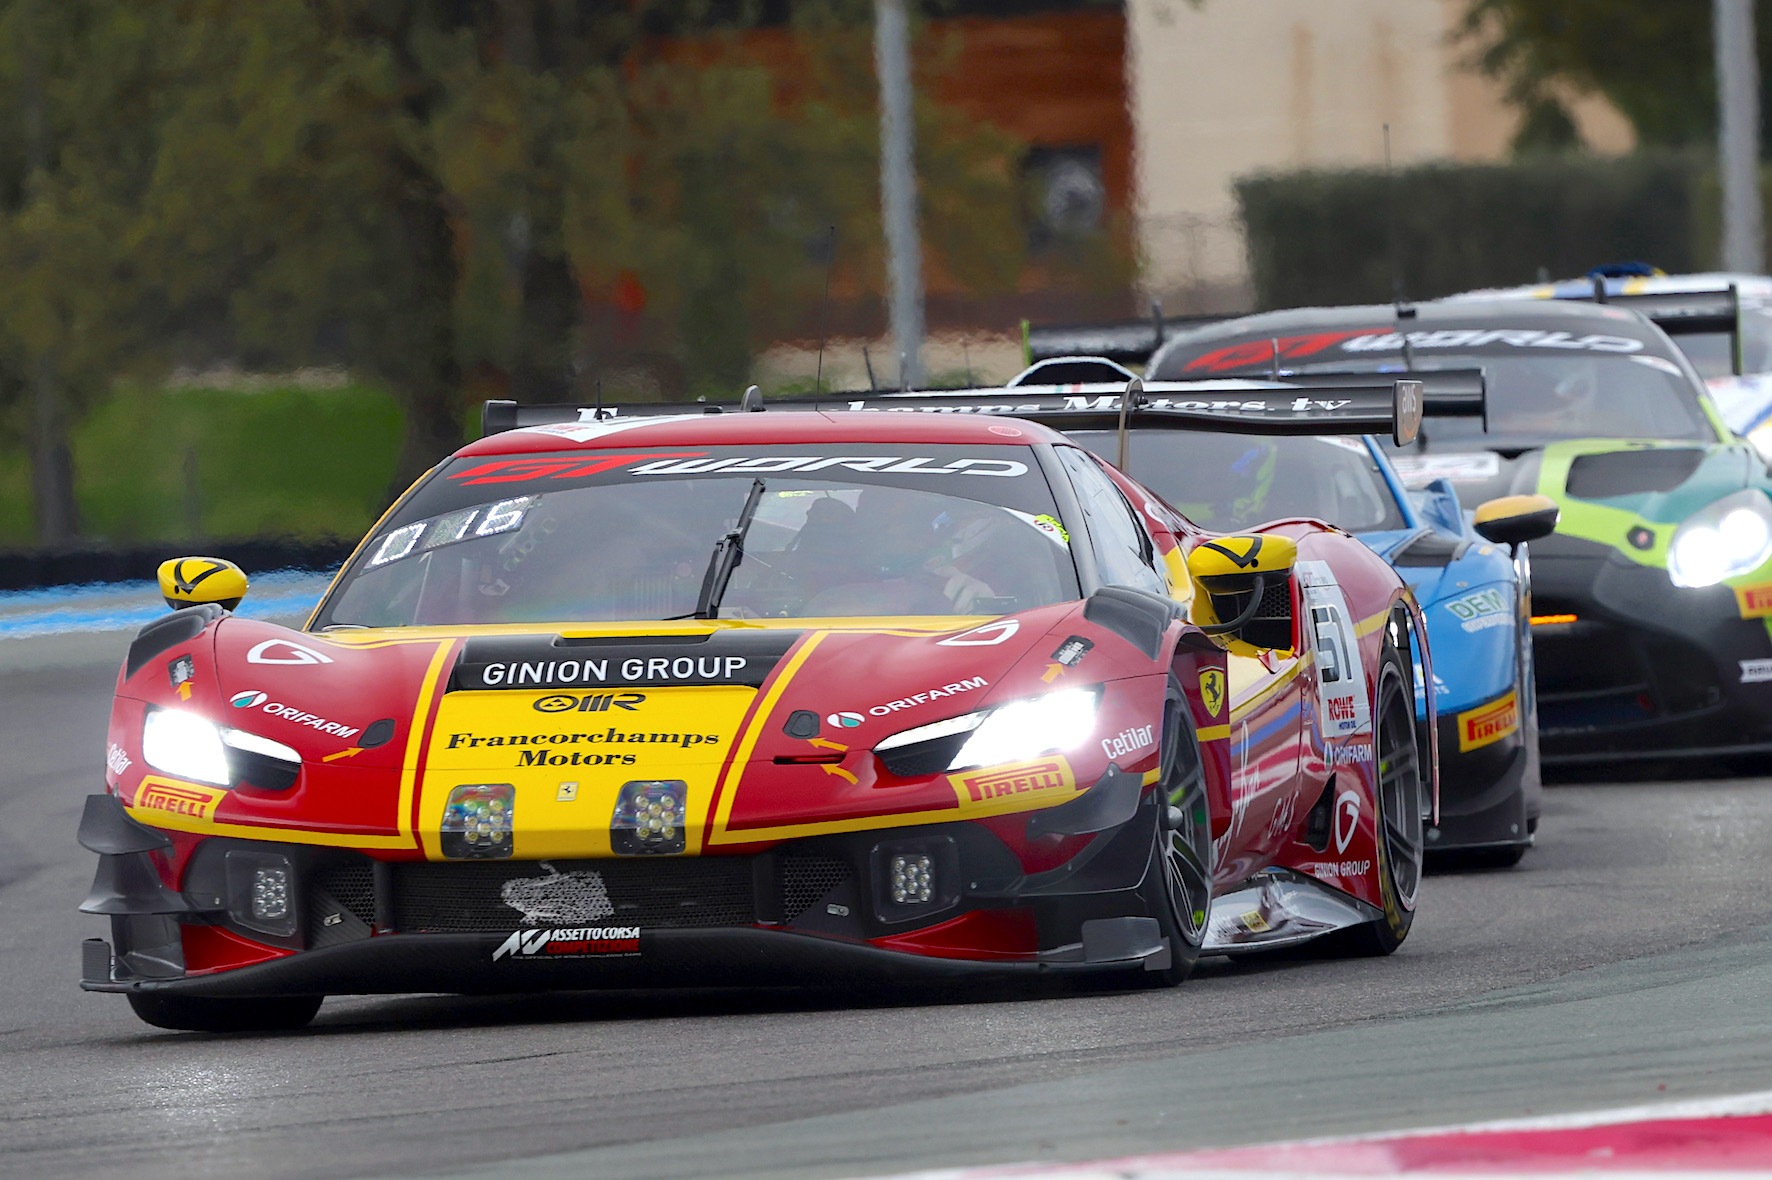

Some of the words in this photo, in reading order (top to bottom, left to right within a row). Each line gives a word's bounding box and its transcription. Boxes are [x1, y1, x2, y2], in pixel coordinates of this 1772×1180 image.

[626, 456, 1029, 477] WORLD
[482, 659, 608, 686] GINION
[620, 655, 747, 681] GROUP
[869, 676, 989, 717] ORIFARM
[1328, 696, 1355, 721] ROWE
[262, 702, 360, 739] ORIFARM
[445, 728, 720, 750] Francorchamps
[1101, 723, 1153, 759] Cetilar
[515, 750, 636, 767] Motors
[1334, 744, 1372, 766] ORIFARM
[963, 763, 1065, 802] PIRELLI
[140, 783, 213, 819] PIRELLI
[1314, 862, 1340, 878] GINION
[1340, 859, 1371, 878] GROUP
[546, 938, 641, 954] COMPETIZIONE
[550, 928, 601, 942] ASSETTO
[602, 927, 641, 940] CORSA
